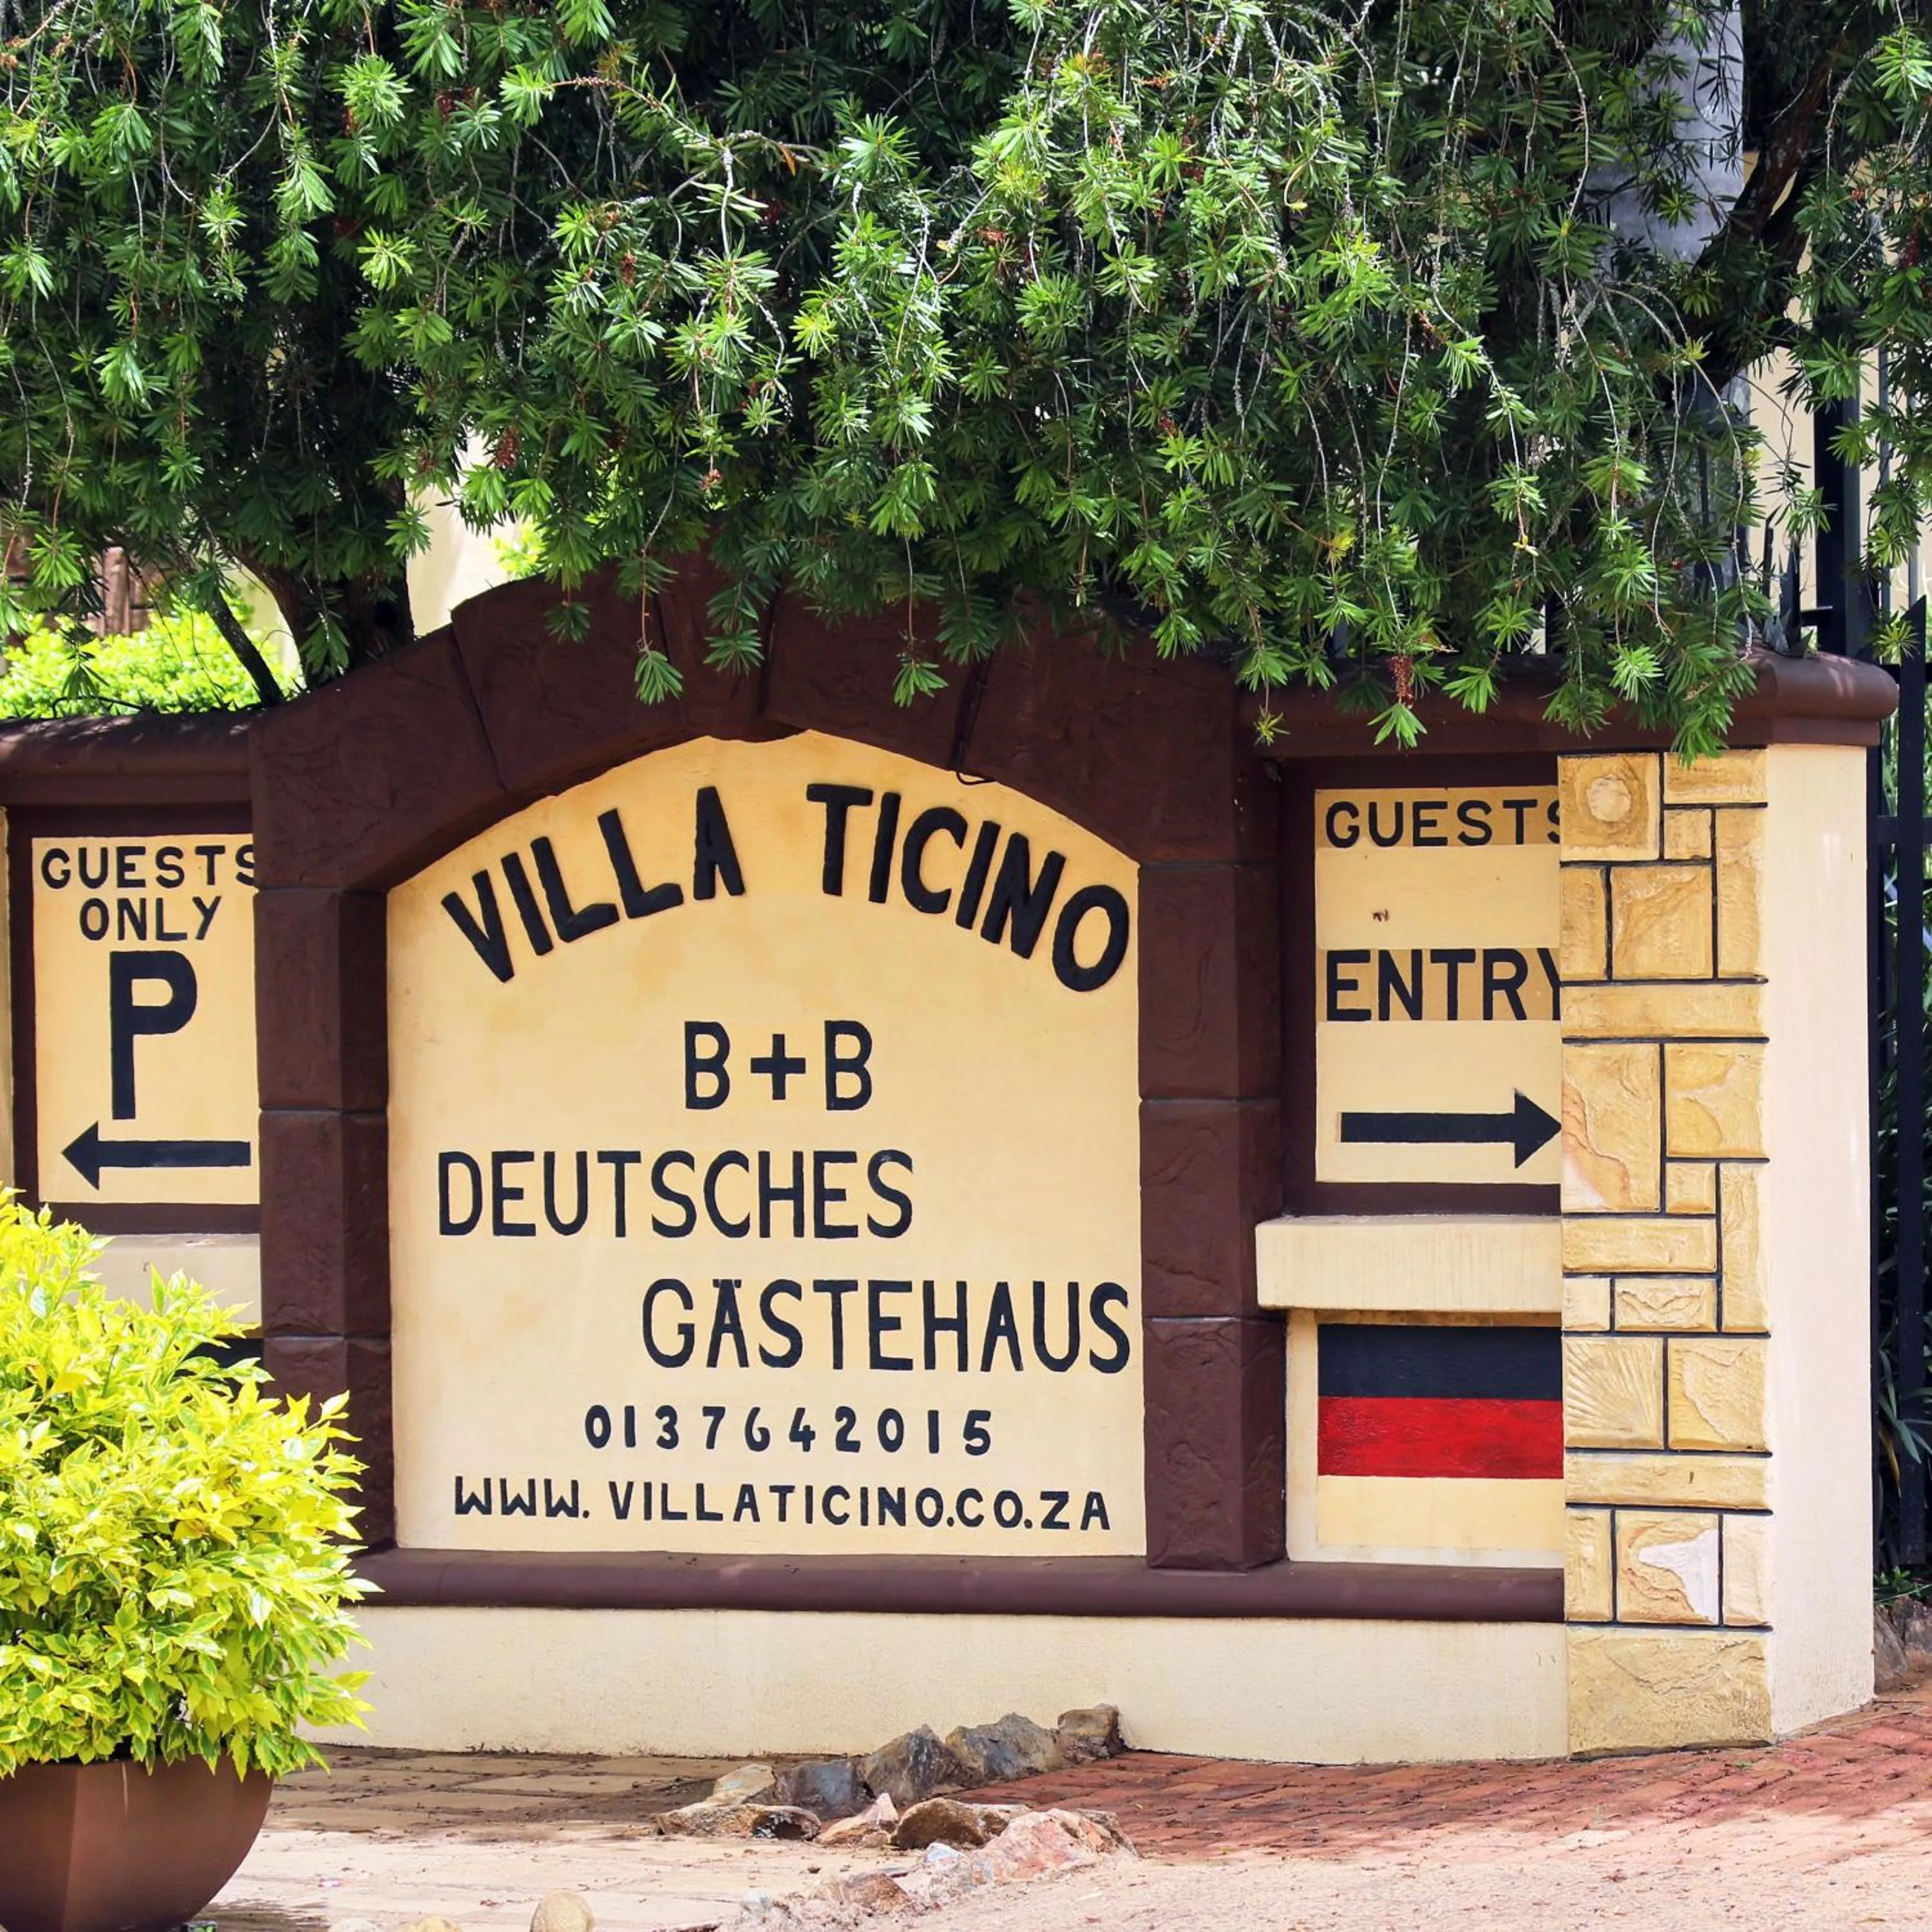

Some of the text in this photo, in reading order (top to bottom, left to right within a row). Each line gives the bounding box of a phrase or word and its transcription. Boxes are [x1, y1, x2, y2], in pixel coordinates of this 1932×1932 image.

[80, 896, 222, 942] ONLY
[442, 783, 1130, 992] VILLA TICINO
[109, 950, 198, 1120] P
[685, 1020, 873, 1111] B+B
[439, 1150, 913, 1239] DEUTSCHES
[643, 1278, 1131, 1374] GÄSTEHAUS
